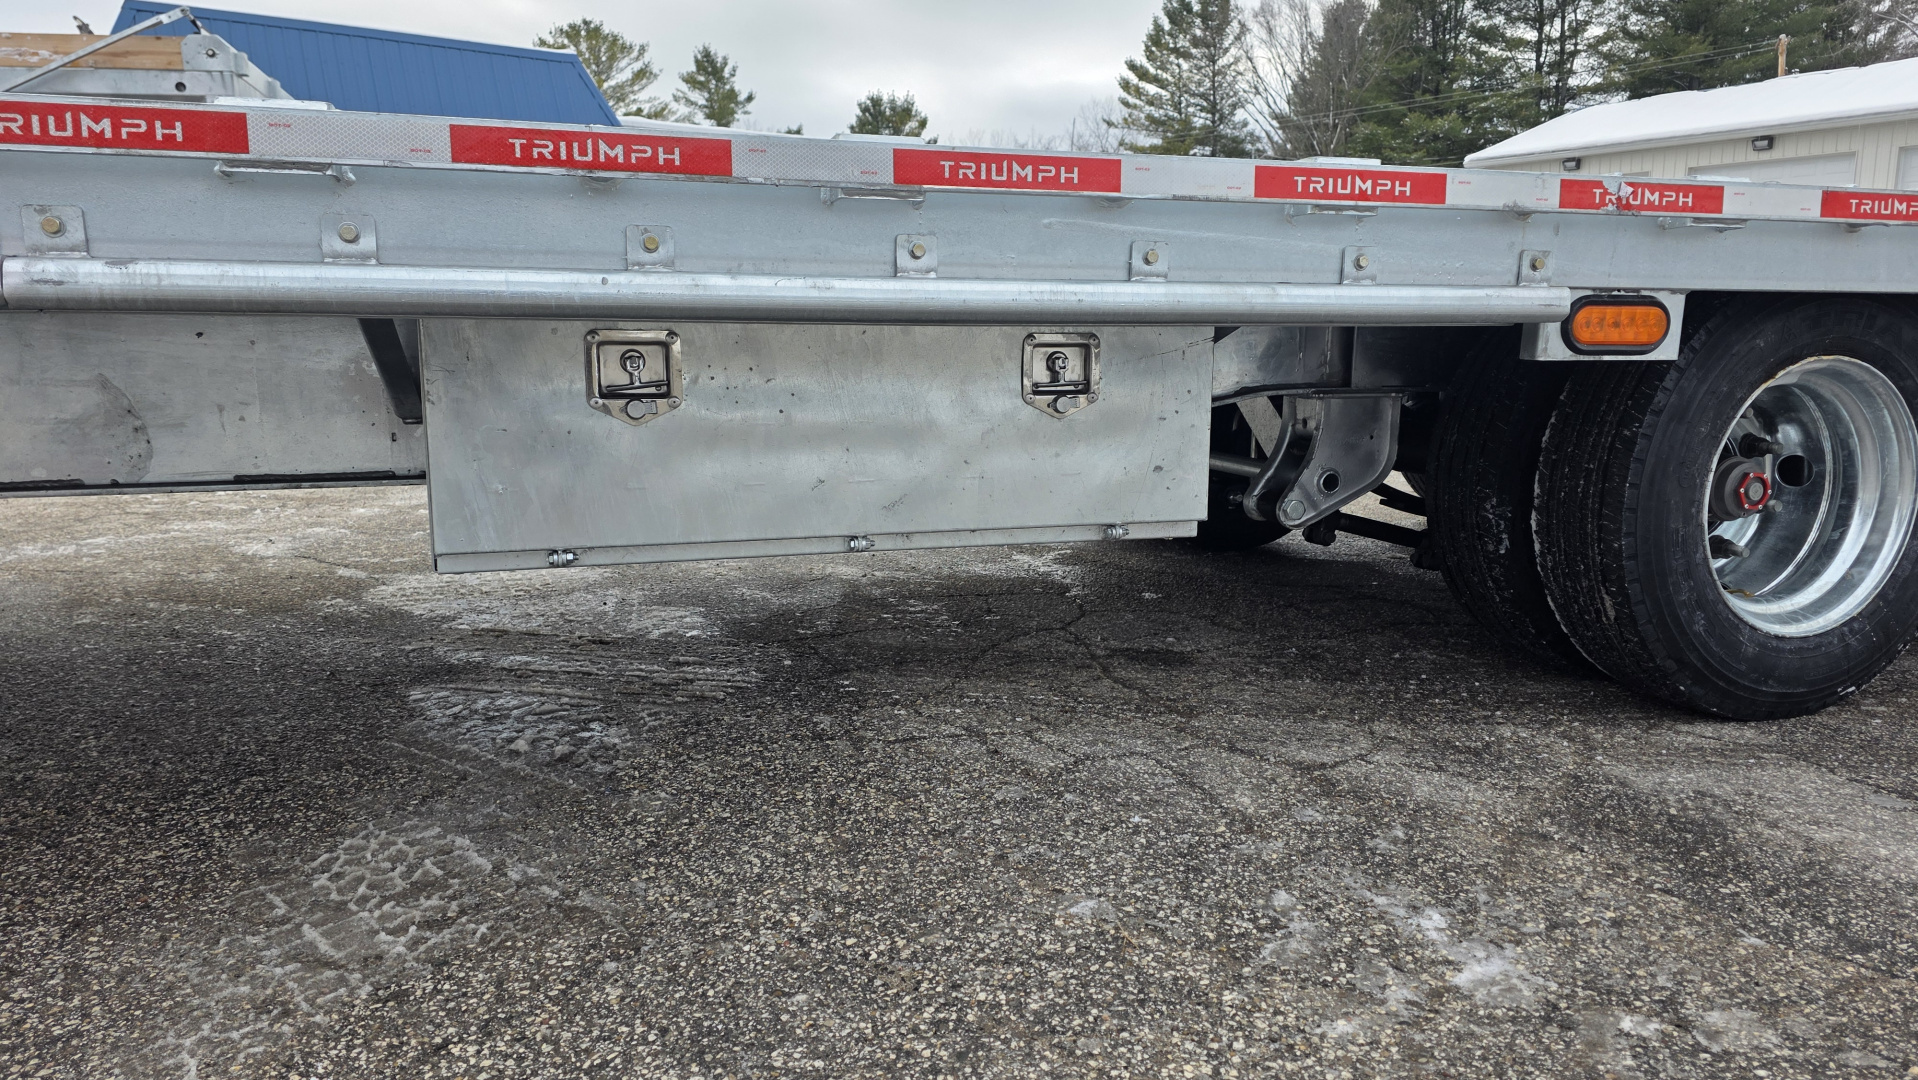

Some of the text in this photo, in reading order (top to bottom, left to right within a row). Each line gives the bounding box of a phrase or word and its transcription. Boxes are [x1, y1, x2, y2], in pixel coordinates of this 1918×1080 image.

[508, 137, 681, 166] TRIUMPH
[939, 159, 1079, 184] TRIUMPH
[1293, 174, 1411, 197] TRIUMPH
